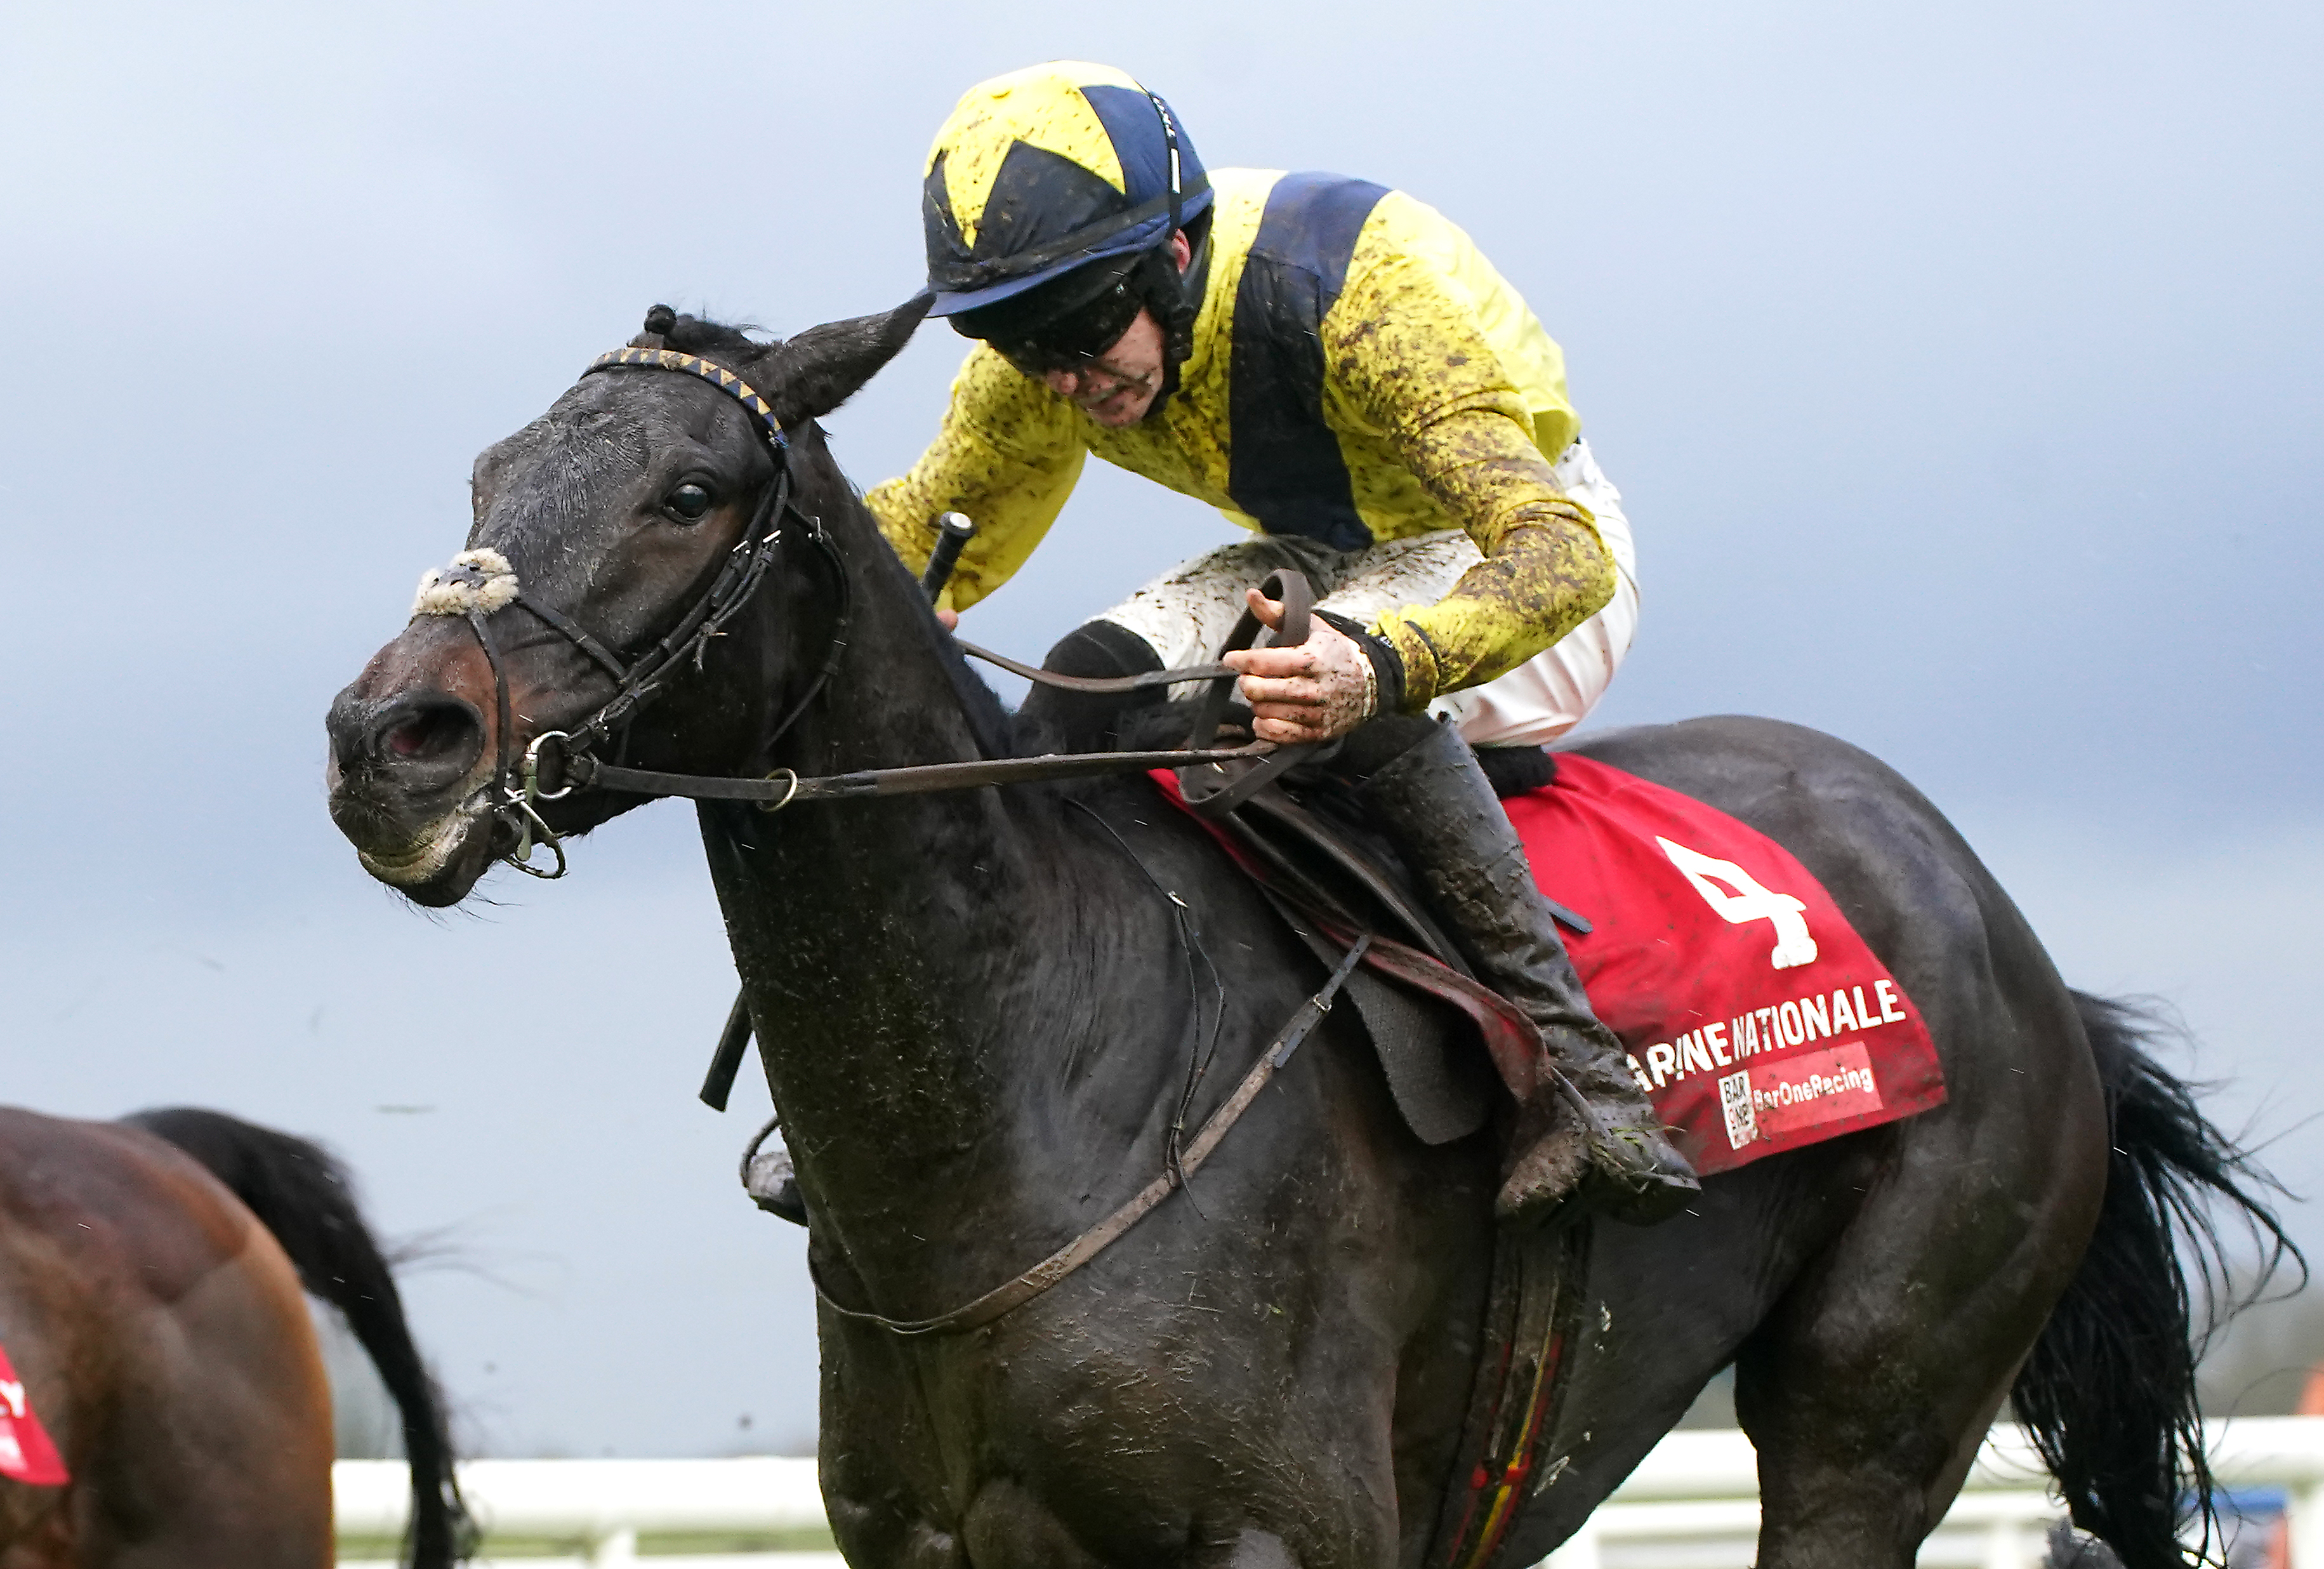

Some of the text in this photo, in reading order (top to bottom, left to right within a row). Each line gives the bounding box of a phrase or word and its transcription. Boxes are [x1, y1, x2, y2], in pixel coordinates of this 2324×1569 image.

[1656, 835, 1818, 970] 4
[1626, 979, 1906, 1092] ARINE NATIONALE
